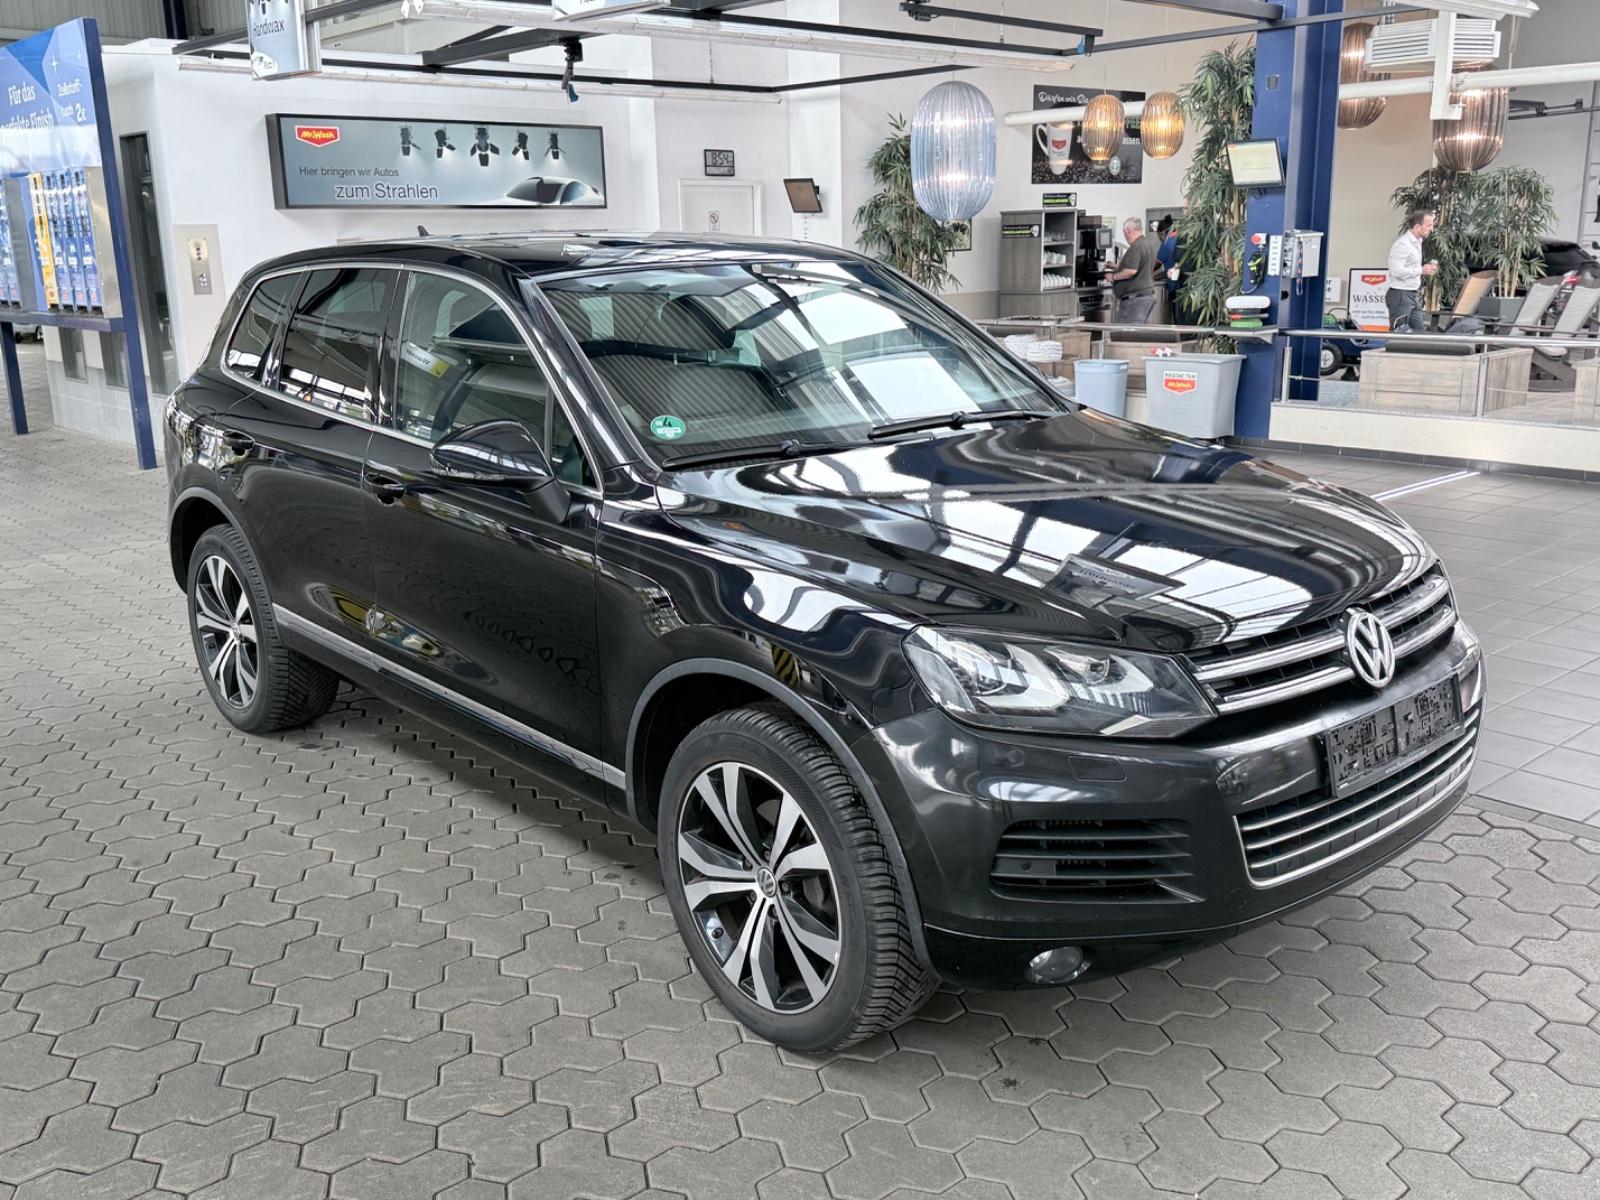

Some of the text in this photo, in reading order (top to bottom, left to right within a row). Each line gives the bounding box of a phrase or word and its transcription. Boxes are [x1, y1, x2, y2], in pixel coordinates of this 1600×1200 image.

[8, 81, 36, 106] Für das
[299, 166, 400, 179] Hier bringen wir Autos
[336, 182, 438, 200] zum Strahlen
[1352, 294, 1387, 303] WASSE
[662, 416, 672, 428] 4
